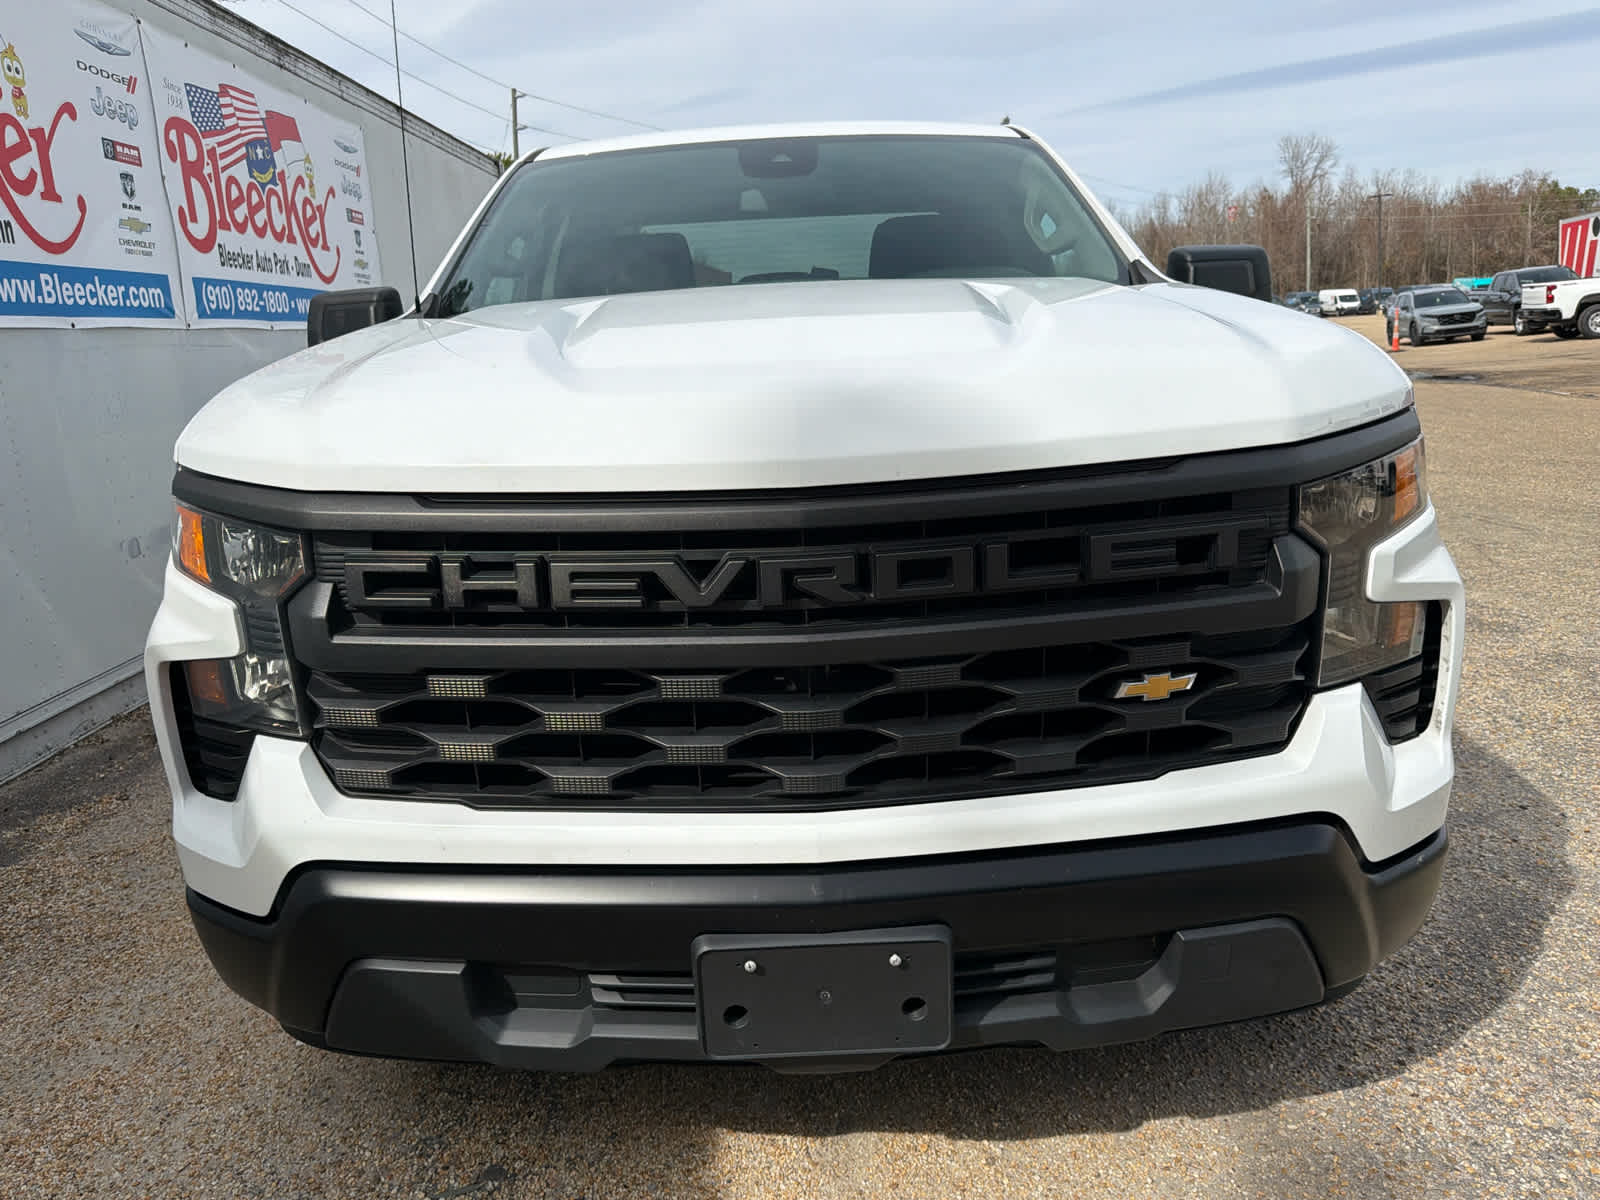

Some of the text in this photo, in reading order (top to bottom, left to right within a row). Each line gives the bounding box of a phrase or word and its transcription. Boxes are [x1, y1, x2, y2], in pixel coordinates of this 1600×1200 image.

[76, 60, 130, 87] DODGE
[90, 86, 138, 131] Jeep
[164, 116, 341, 285] Bleecker
[118, 238, 156, 249] CHEVROLET
[217, 243, 254, 271] Bleecker
[255, 249, 273, 273] Auto
[273, 252, 291, 276] Park
[294, 256, 313, 278] Dunn
[202, 281, 235, 316] (910)
[236, 287, 289, 313] 892-1800
[343, 514, 1270, 613] CHEVROLET
